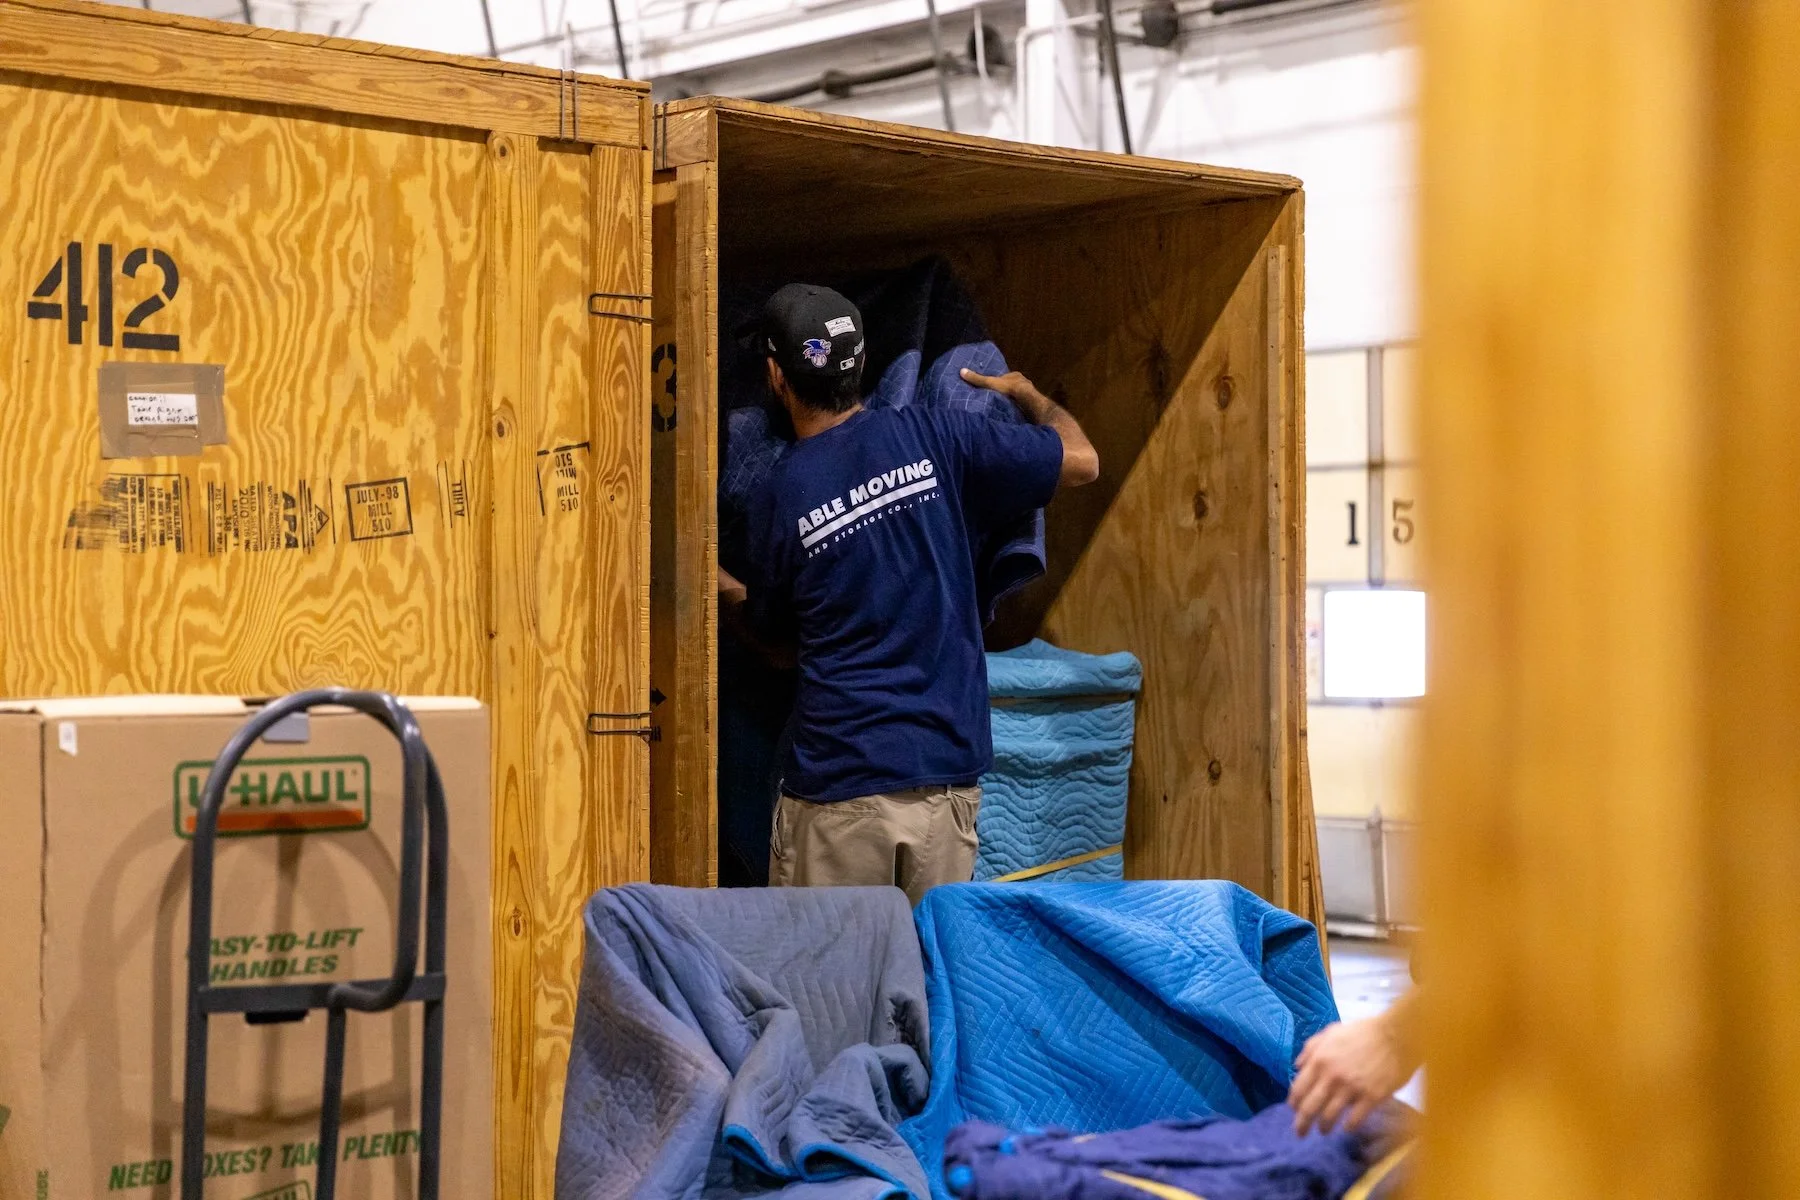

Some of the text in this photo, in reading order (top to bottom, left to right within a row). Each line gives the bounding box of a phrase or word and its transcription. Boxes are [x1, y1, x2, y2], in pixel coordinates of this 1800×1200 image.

[27, 241, 180, 351] 412
[357, 486, 399, 504] JULY-98
[557, 484, 579, 497] MILL
[798, 459, 933, 536] ABLE MOVING
[282, 491, 299, 549] APA
[368, 502, 392, 518] MILL
[560, 499, 579, 512] 510
[372, 517, 391, 533] 510
[808, 492, 940, 558] AND STORAGE CO., INC.
[209, 927, 364, 957] ASY-TO-LIFT
[210, 954, 338, 982] HANDLES
[108, 1129, 422, 1191] NEED OXES? TAK PLENTY
